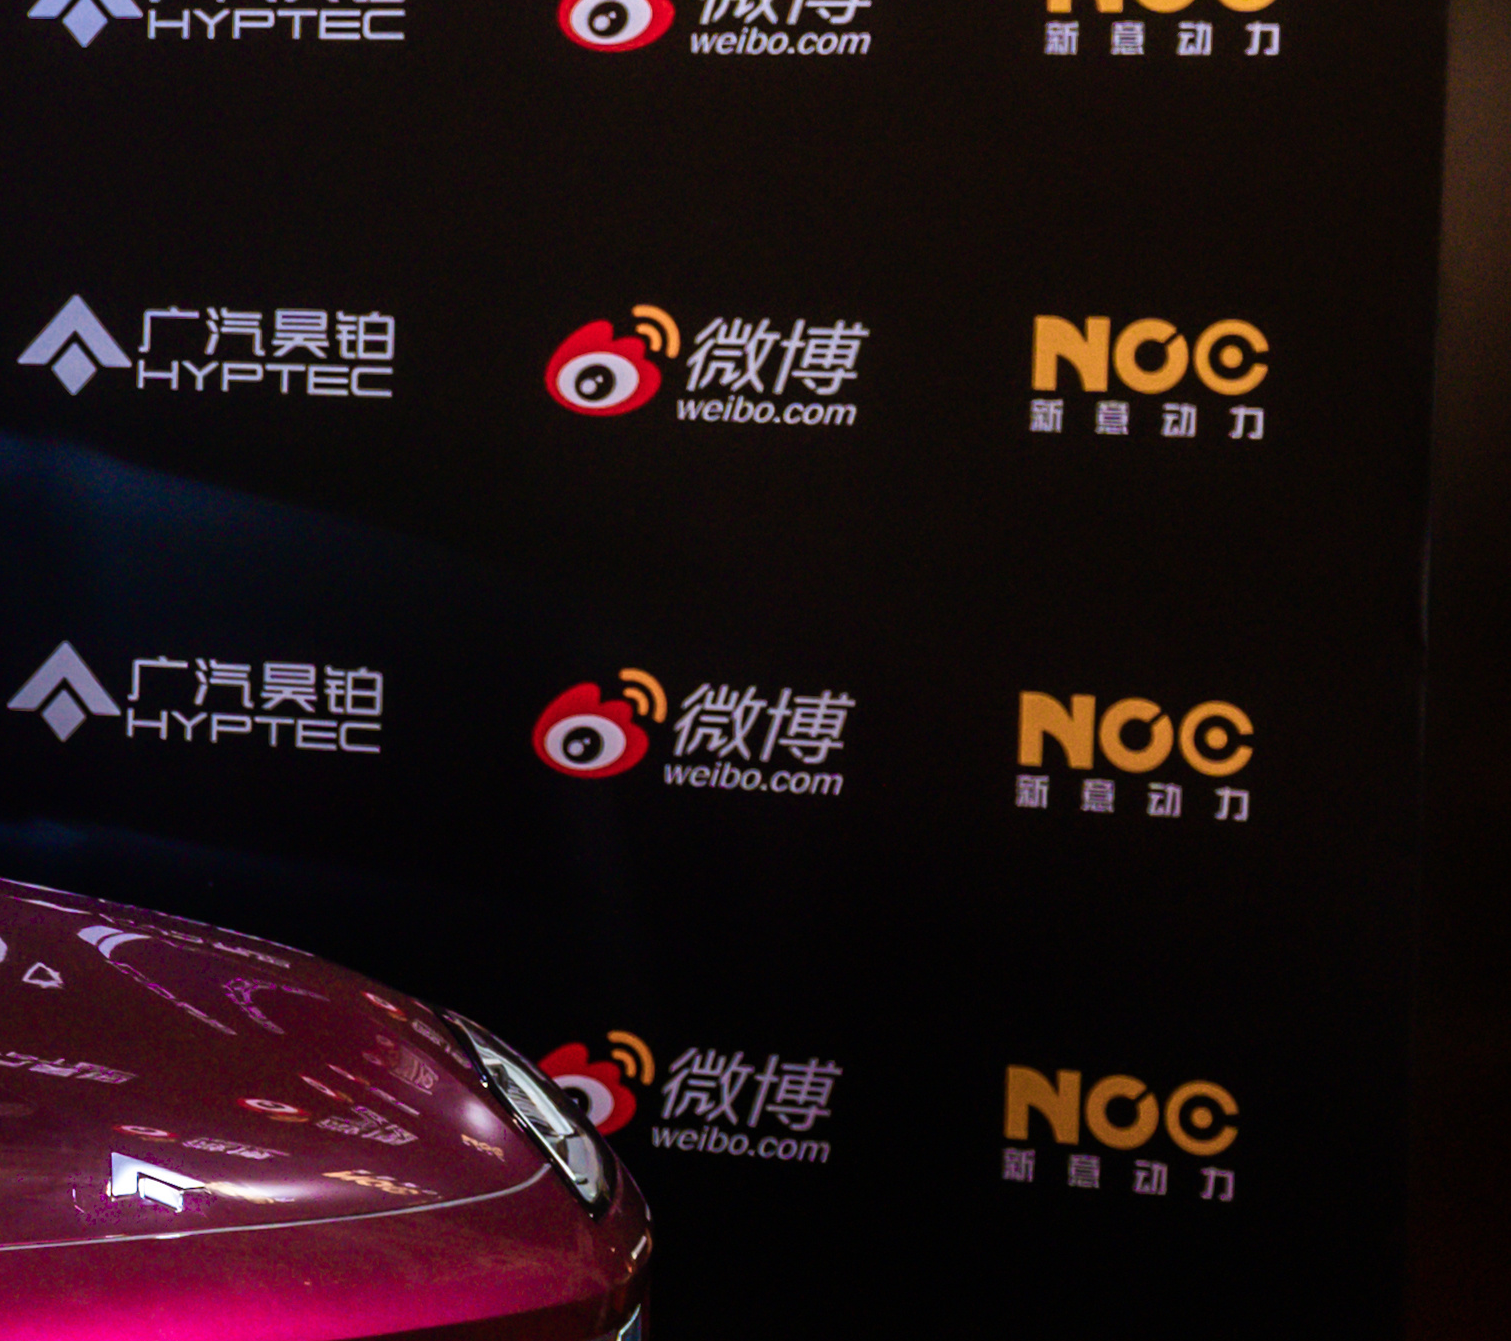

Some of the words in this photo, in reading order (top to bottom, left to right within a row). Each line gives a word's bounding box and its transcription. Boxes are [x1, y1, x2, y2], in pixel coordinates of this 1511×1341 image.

[147, 8, 406, 41] HYPTEC
[690, 26, 872, 56] weibo.com
[1044, 20, 1281, 56] 新意动力
[138, 306, 396, 361] 广汽昊铂
[686, 317, 870, 396] 微博
[1031, 314, 1269, 396] NOC
[137, 358, 394, 398] HYPTEC
[677, 394, 857, 426] weibo.com
[1029, 398, 1265, 440] 新意动力
[127, 655, 384, 716] 广汽昊铂
[126, 707, 382, 753] HYPTEC
[674, 683, 856, 764] 微博
[1017, 691, 1254, 777] NOC
[664, 761, 844, 796] weibo.com
[1015, 774, 1250, 822] 新意动力
[661, 1047, 842, 1131] 微博
[1004, 1065, 1239, 1156] NOC
[652, 1125, 831, 1164] weibo.com
[1002, 1147, 1235, 1202] 新意动力
